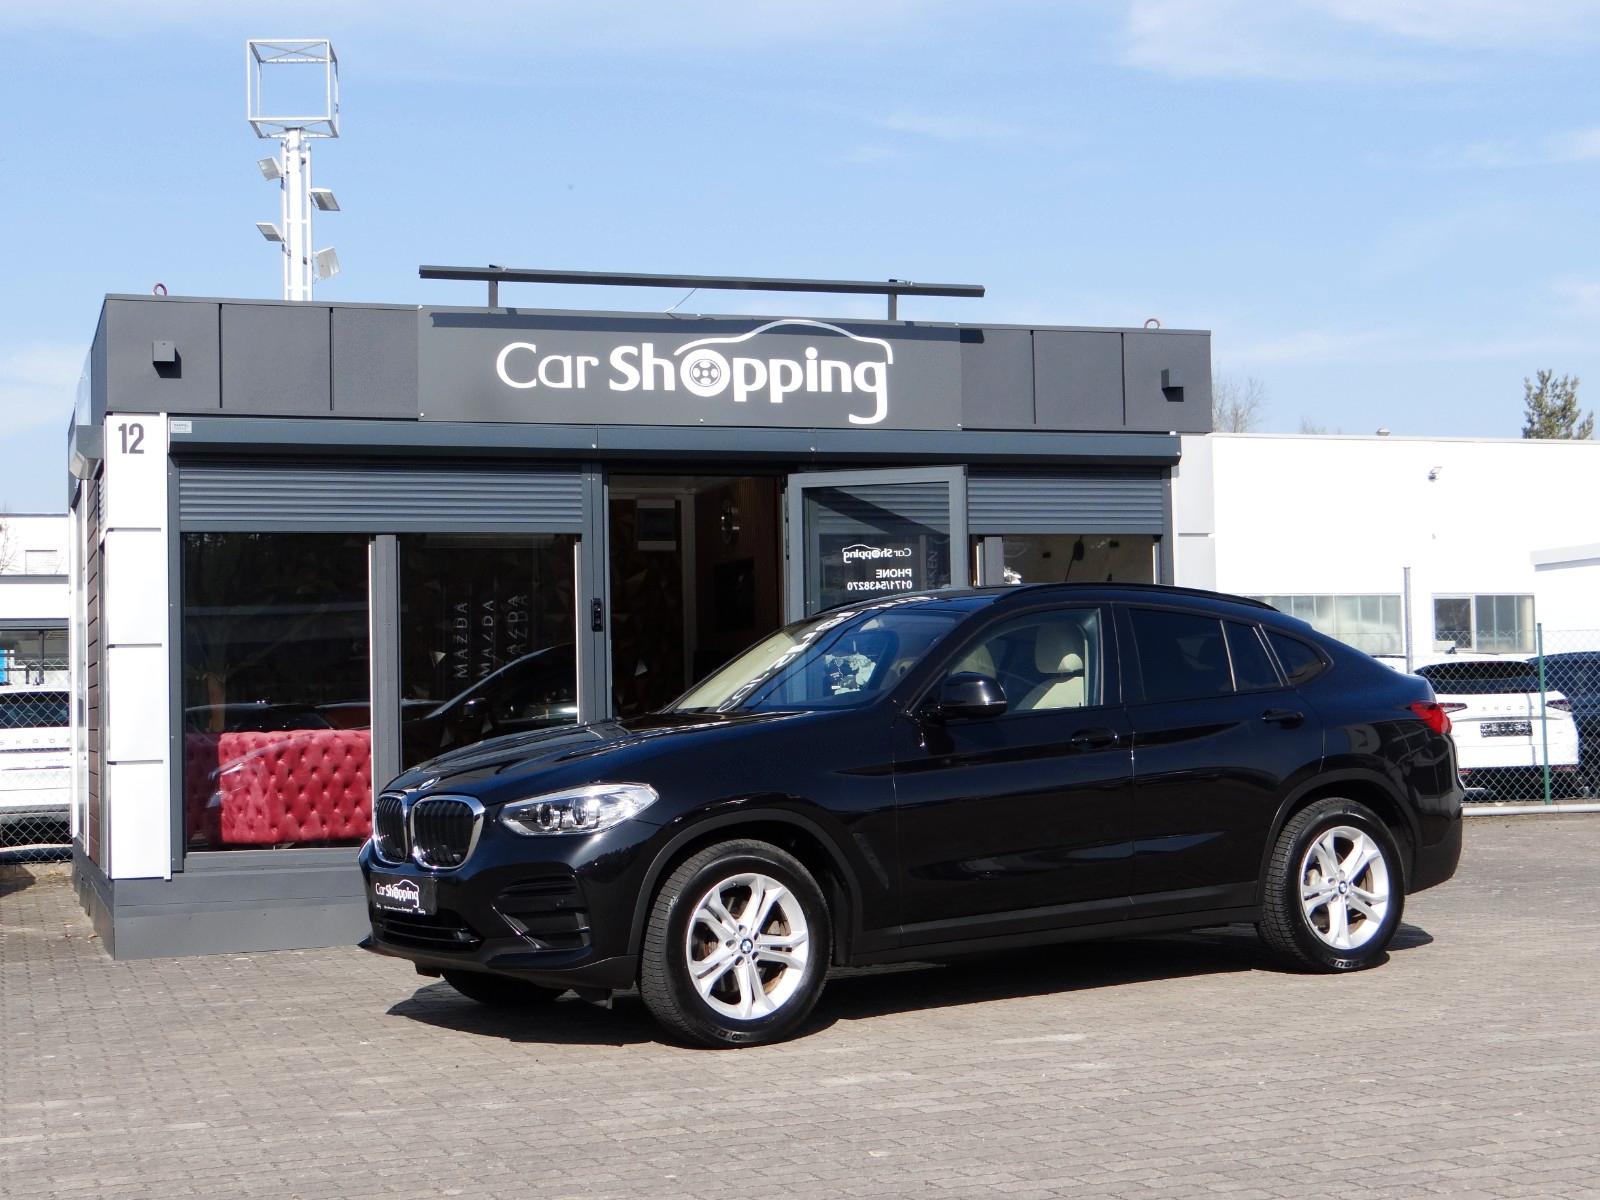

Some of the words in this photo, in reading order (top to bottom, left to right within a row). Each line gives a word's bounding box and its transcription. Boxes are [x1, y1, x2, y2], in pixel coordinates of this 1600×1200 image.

[496, 342, 599, 389] Car
[609, 342, 888, 425] Shopping
[118, 423, 144, 454] 12
[455, 602, 469, 678] MAZDA
[376, 882, 386, 896] Car
[386, 884, 420, 908] Shopping
